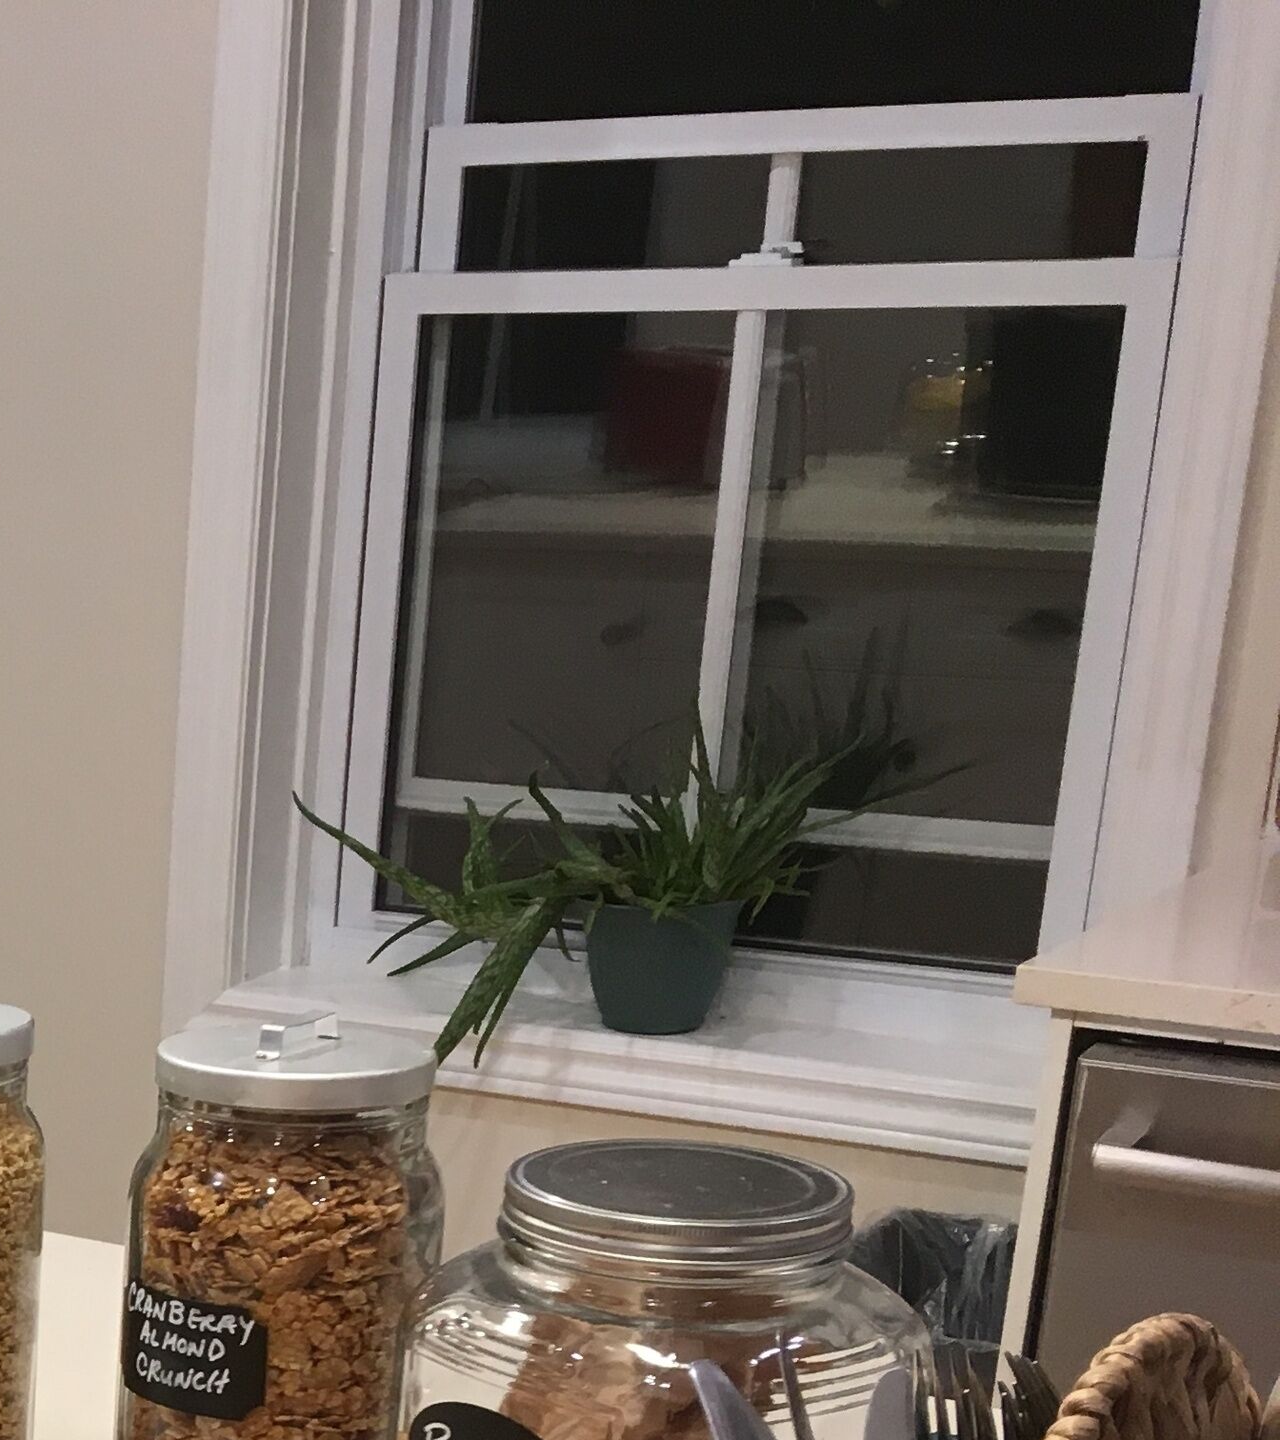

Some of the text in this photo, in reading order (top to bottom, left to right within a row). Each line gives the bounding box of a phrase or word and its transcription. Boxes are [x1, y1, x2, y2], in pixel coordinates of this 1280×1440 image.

[127, 1281, 255, 1346] CRANBERRY
[139, 1319, 226, 1362] ALMOND
[135, 1351, 231, 1395] CRUNCH
